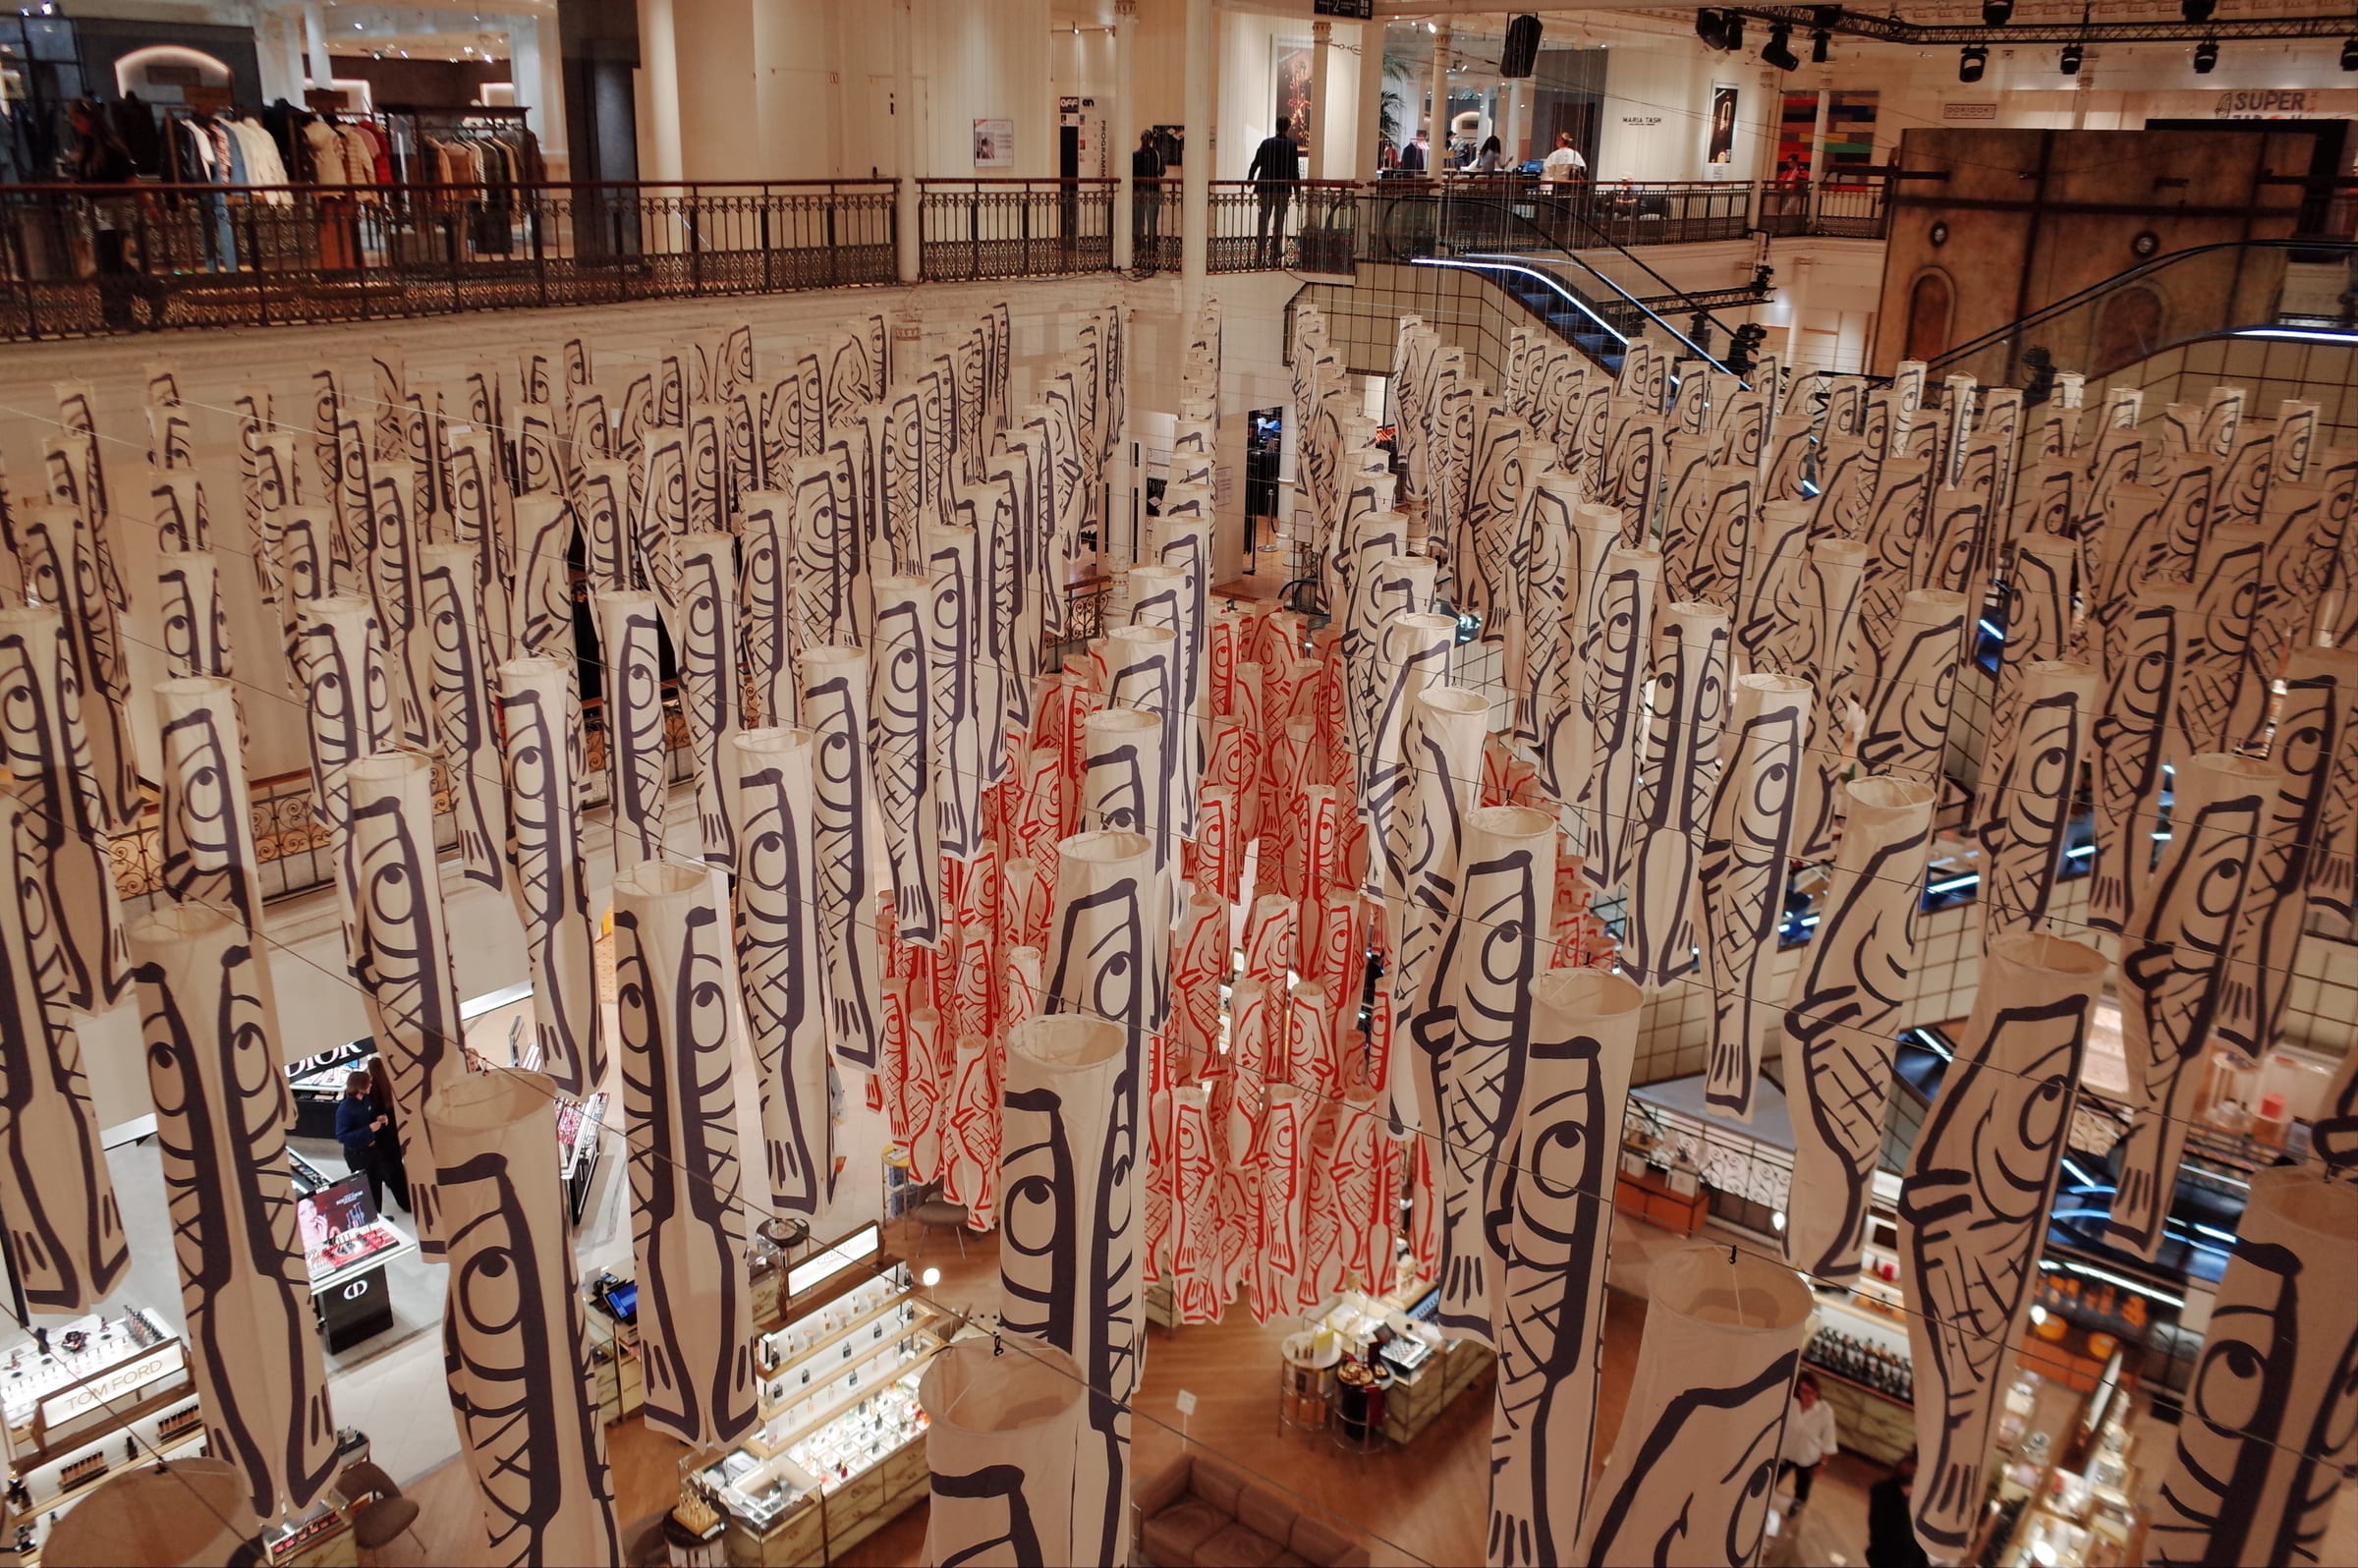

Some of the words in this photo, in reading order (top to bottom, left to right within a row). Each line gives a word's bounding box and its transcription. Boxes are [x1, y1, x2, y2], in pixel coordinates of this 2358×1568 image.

[1060, 98, 1079, 108] OFF
[2234, 90, 2306, 111] SUPER
[65, 1383, 108, 1411] TOM
[111, 1360, 163, 1391] FORD
